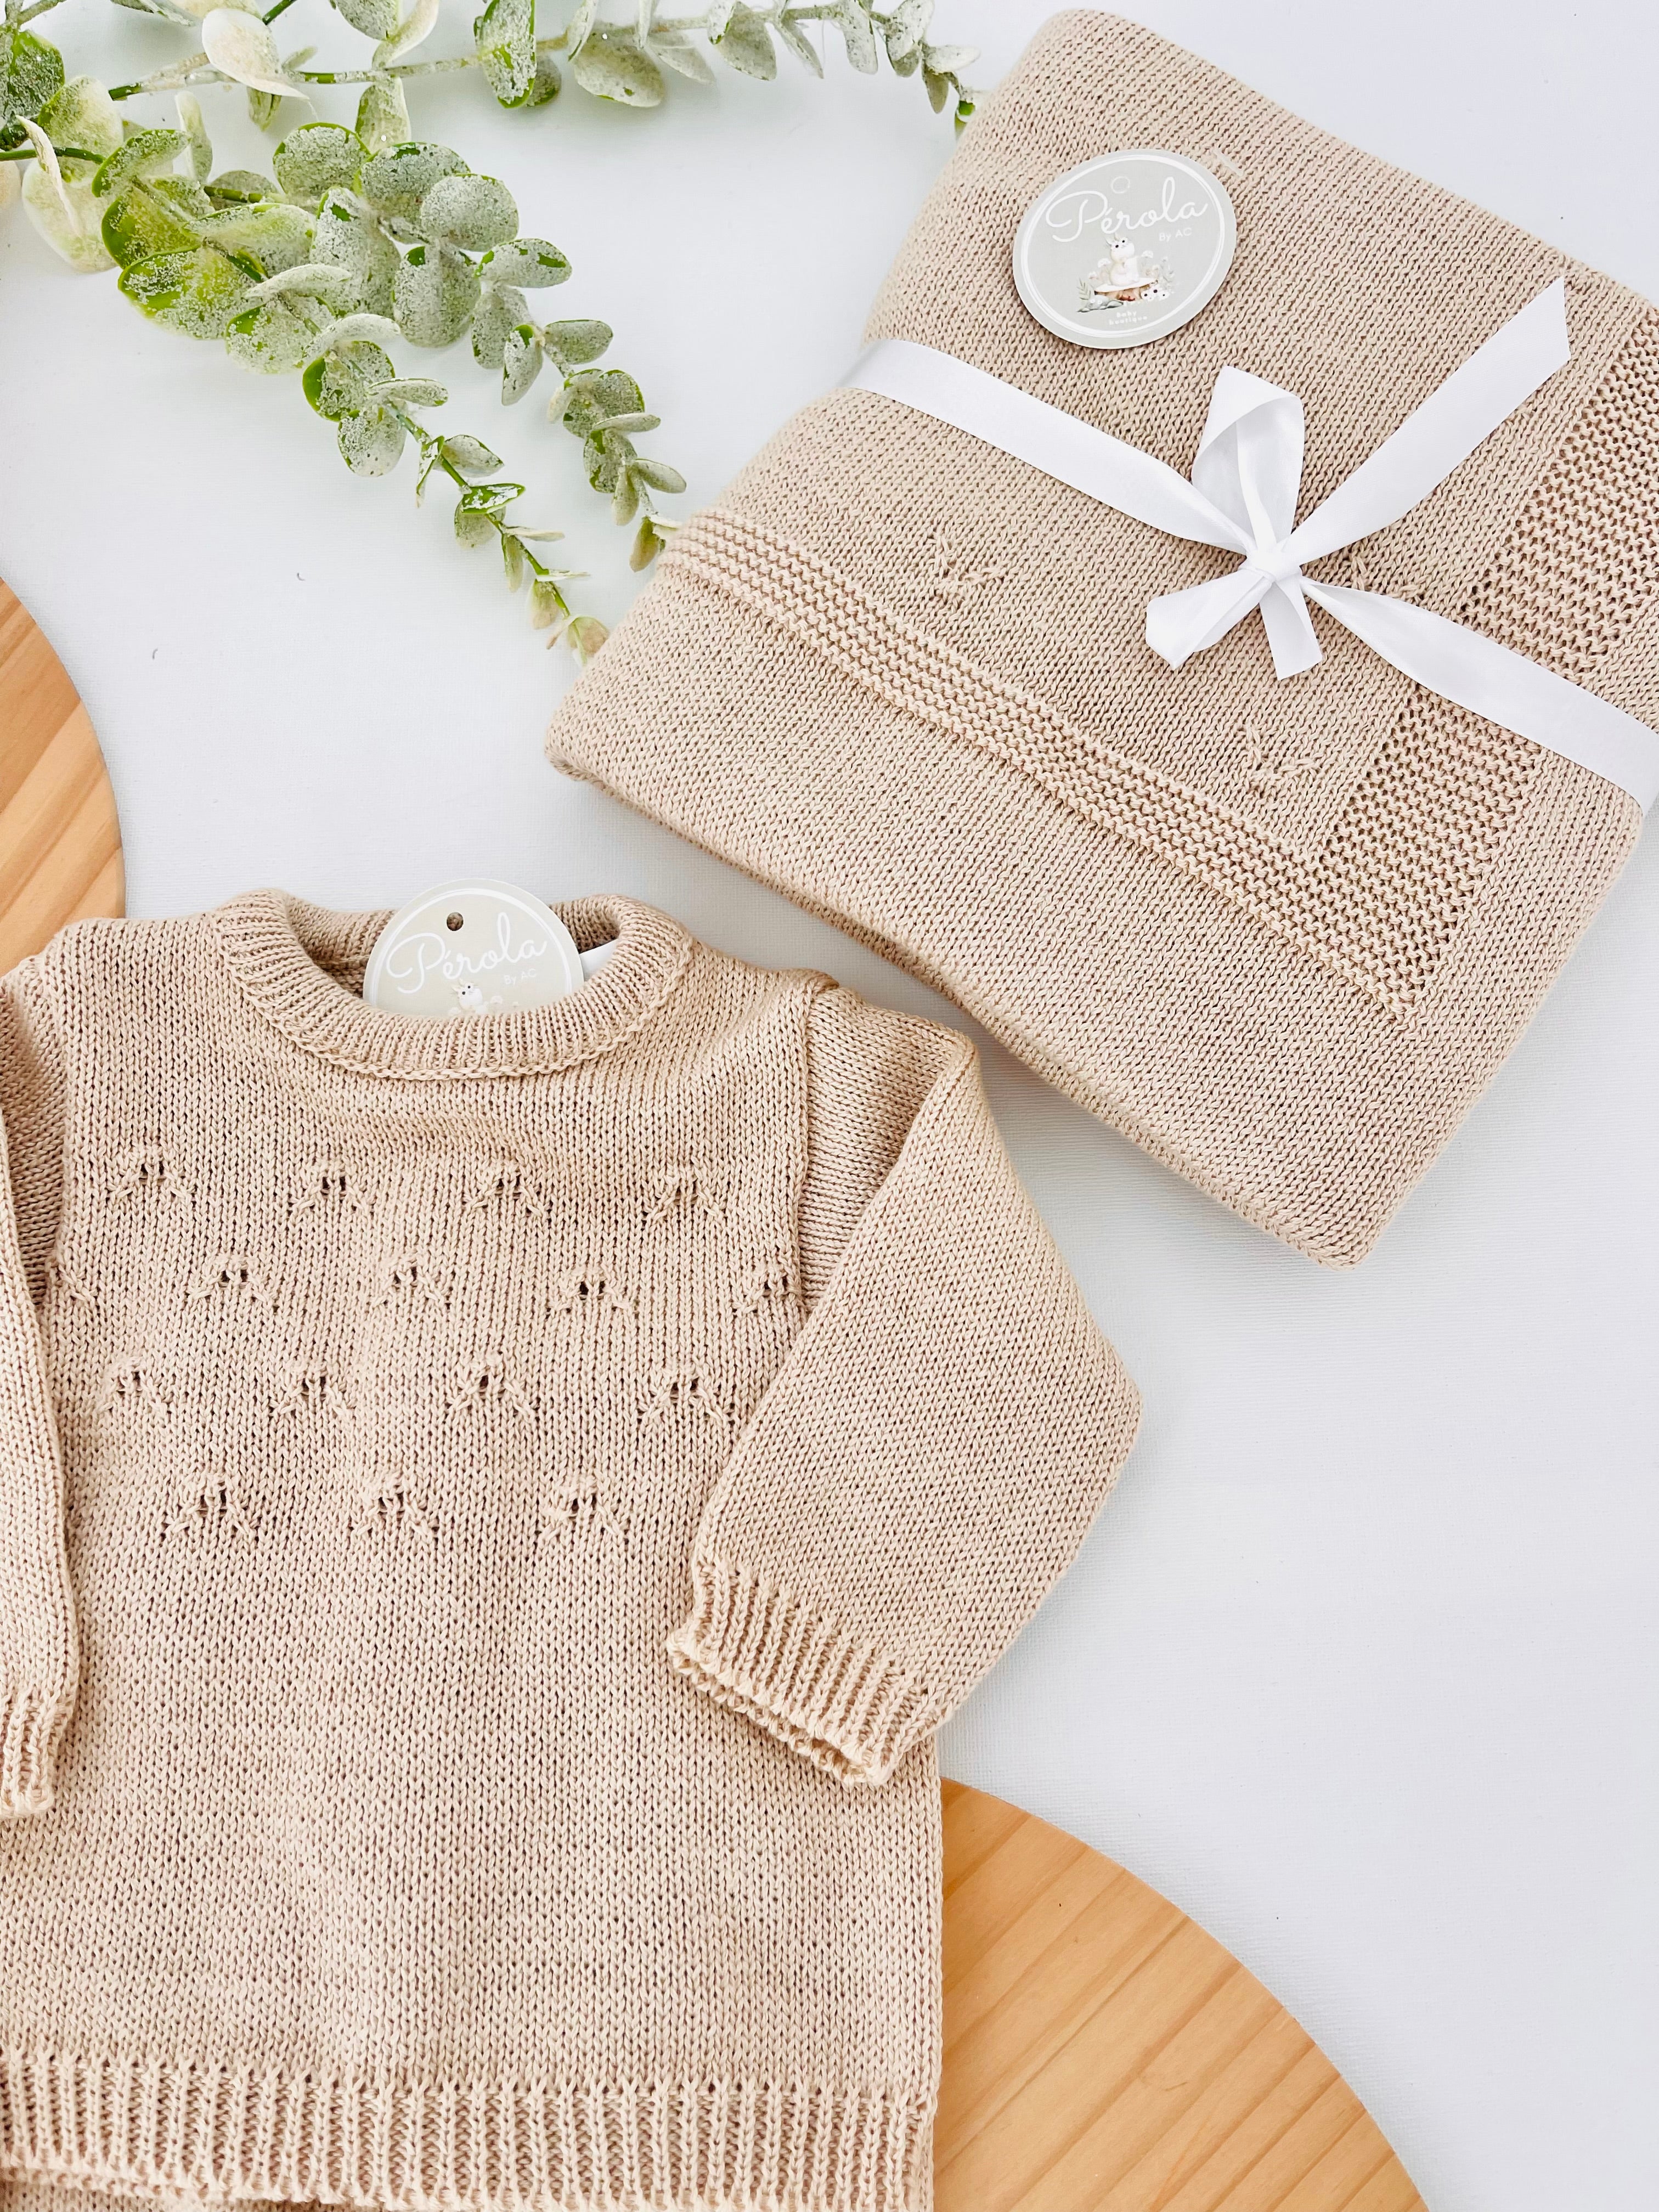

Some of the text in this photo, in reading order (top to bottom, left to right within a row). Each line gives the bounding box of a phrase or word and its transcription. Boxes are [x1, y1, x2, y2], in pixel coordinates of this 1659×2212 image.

[1046, 177, 1208, 242] Pérola
[1159, 228, 1192, 242] By AC
[386, 912, 548, 994] Pérola
[521, 968, 537, 980] AC
